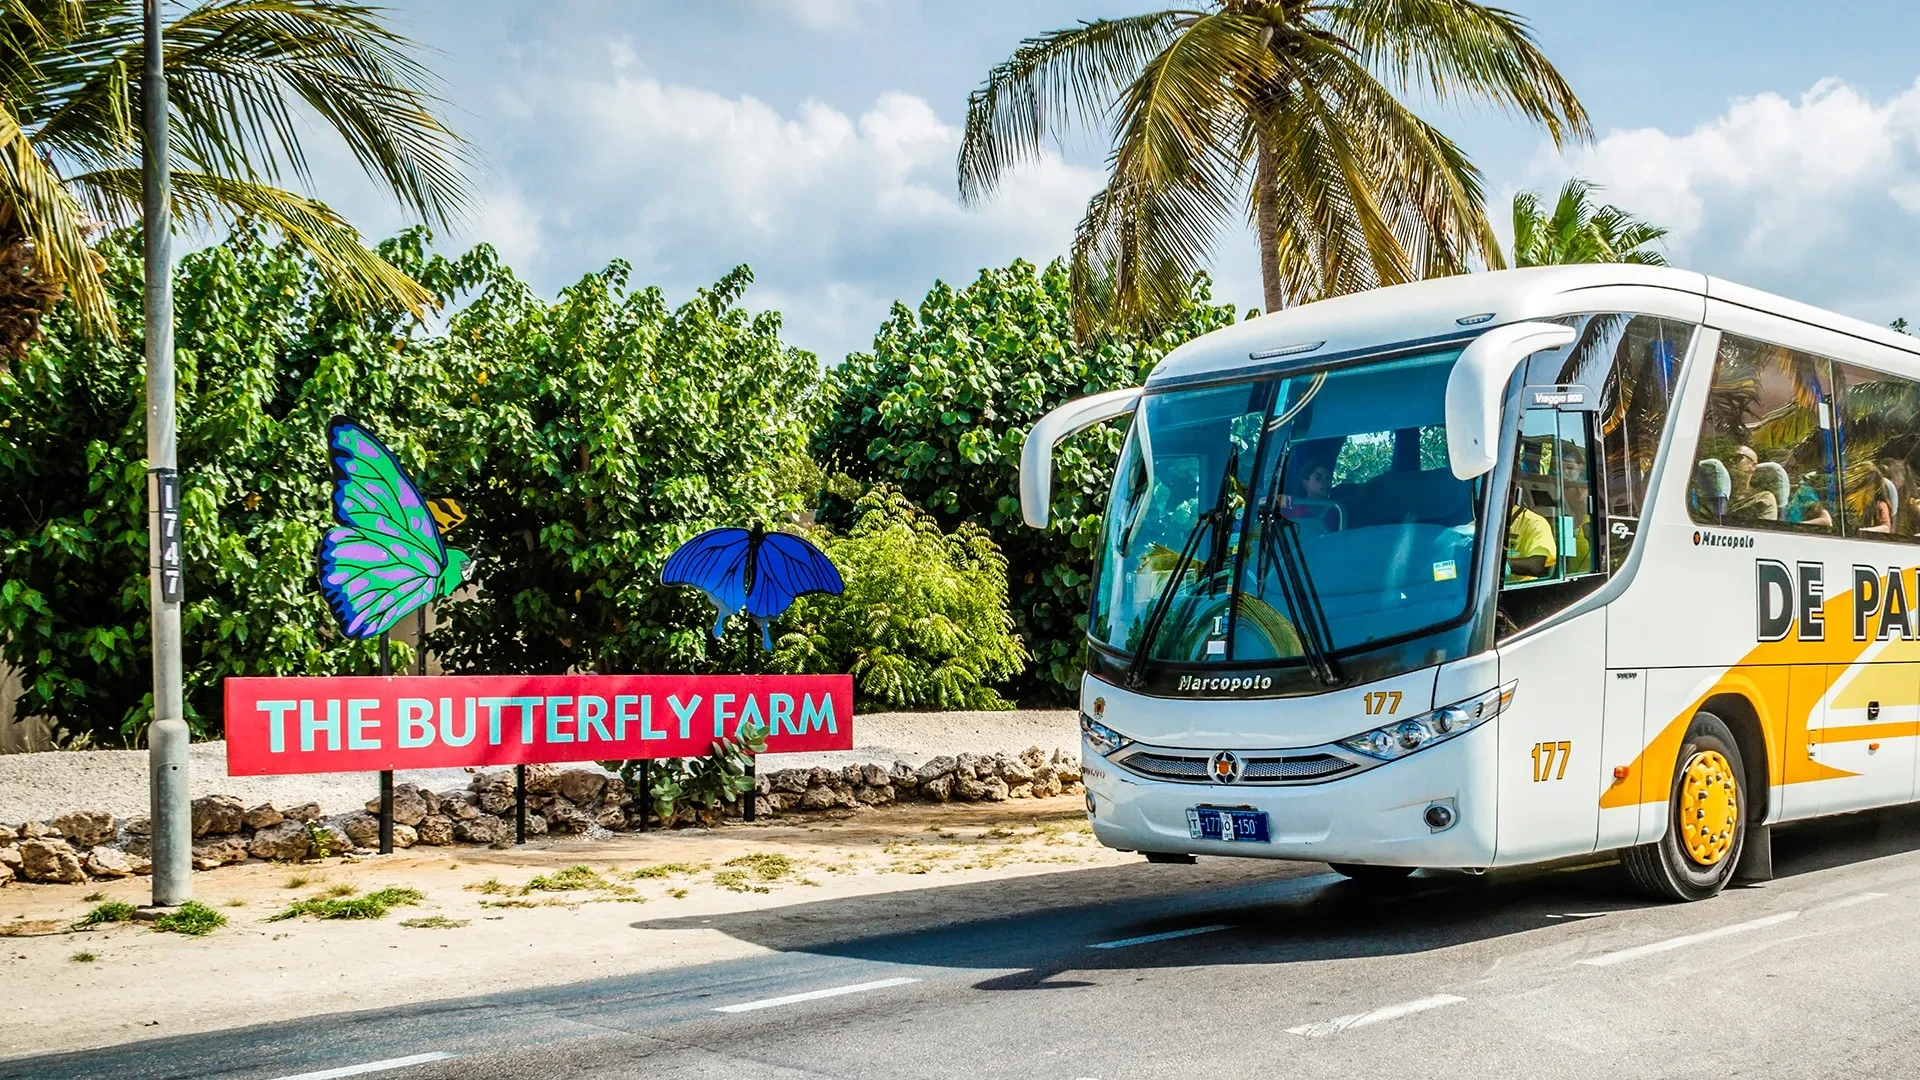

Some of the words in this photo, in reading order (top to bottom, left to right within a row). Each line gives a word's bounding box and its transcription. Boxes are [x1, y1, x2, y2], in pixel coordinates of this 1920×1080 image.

[162, 485, 179, 594] 1747
[1702, 531, 1755, 549] Marcopolo
[1755, 558, 1825, 642] DE
[1178, 674, 1272, 691] Marcopolo
[1363, 691, 1403, 715] 177
[256, 698, 382, 752] THE
[398, 695, 703, 747] BUTTERFLY
[713, 693, 837, 736] FARM
[1531, 740, 1572, 782] 177
